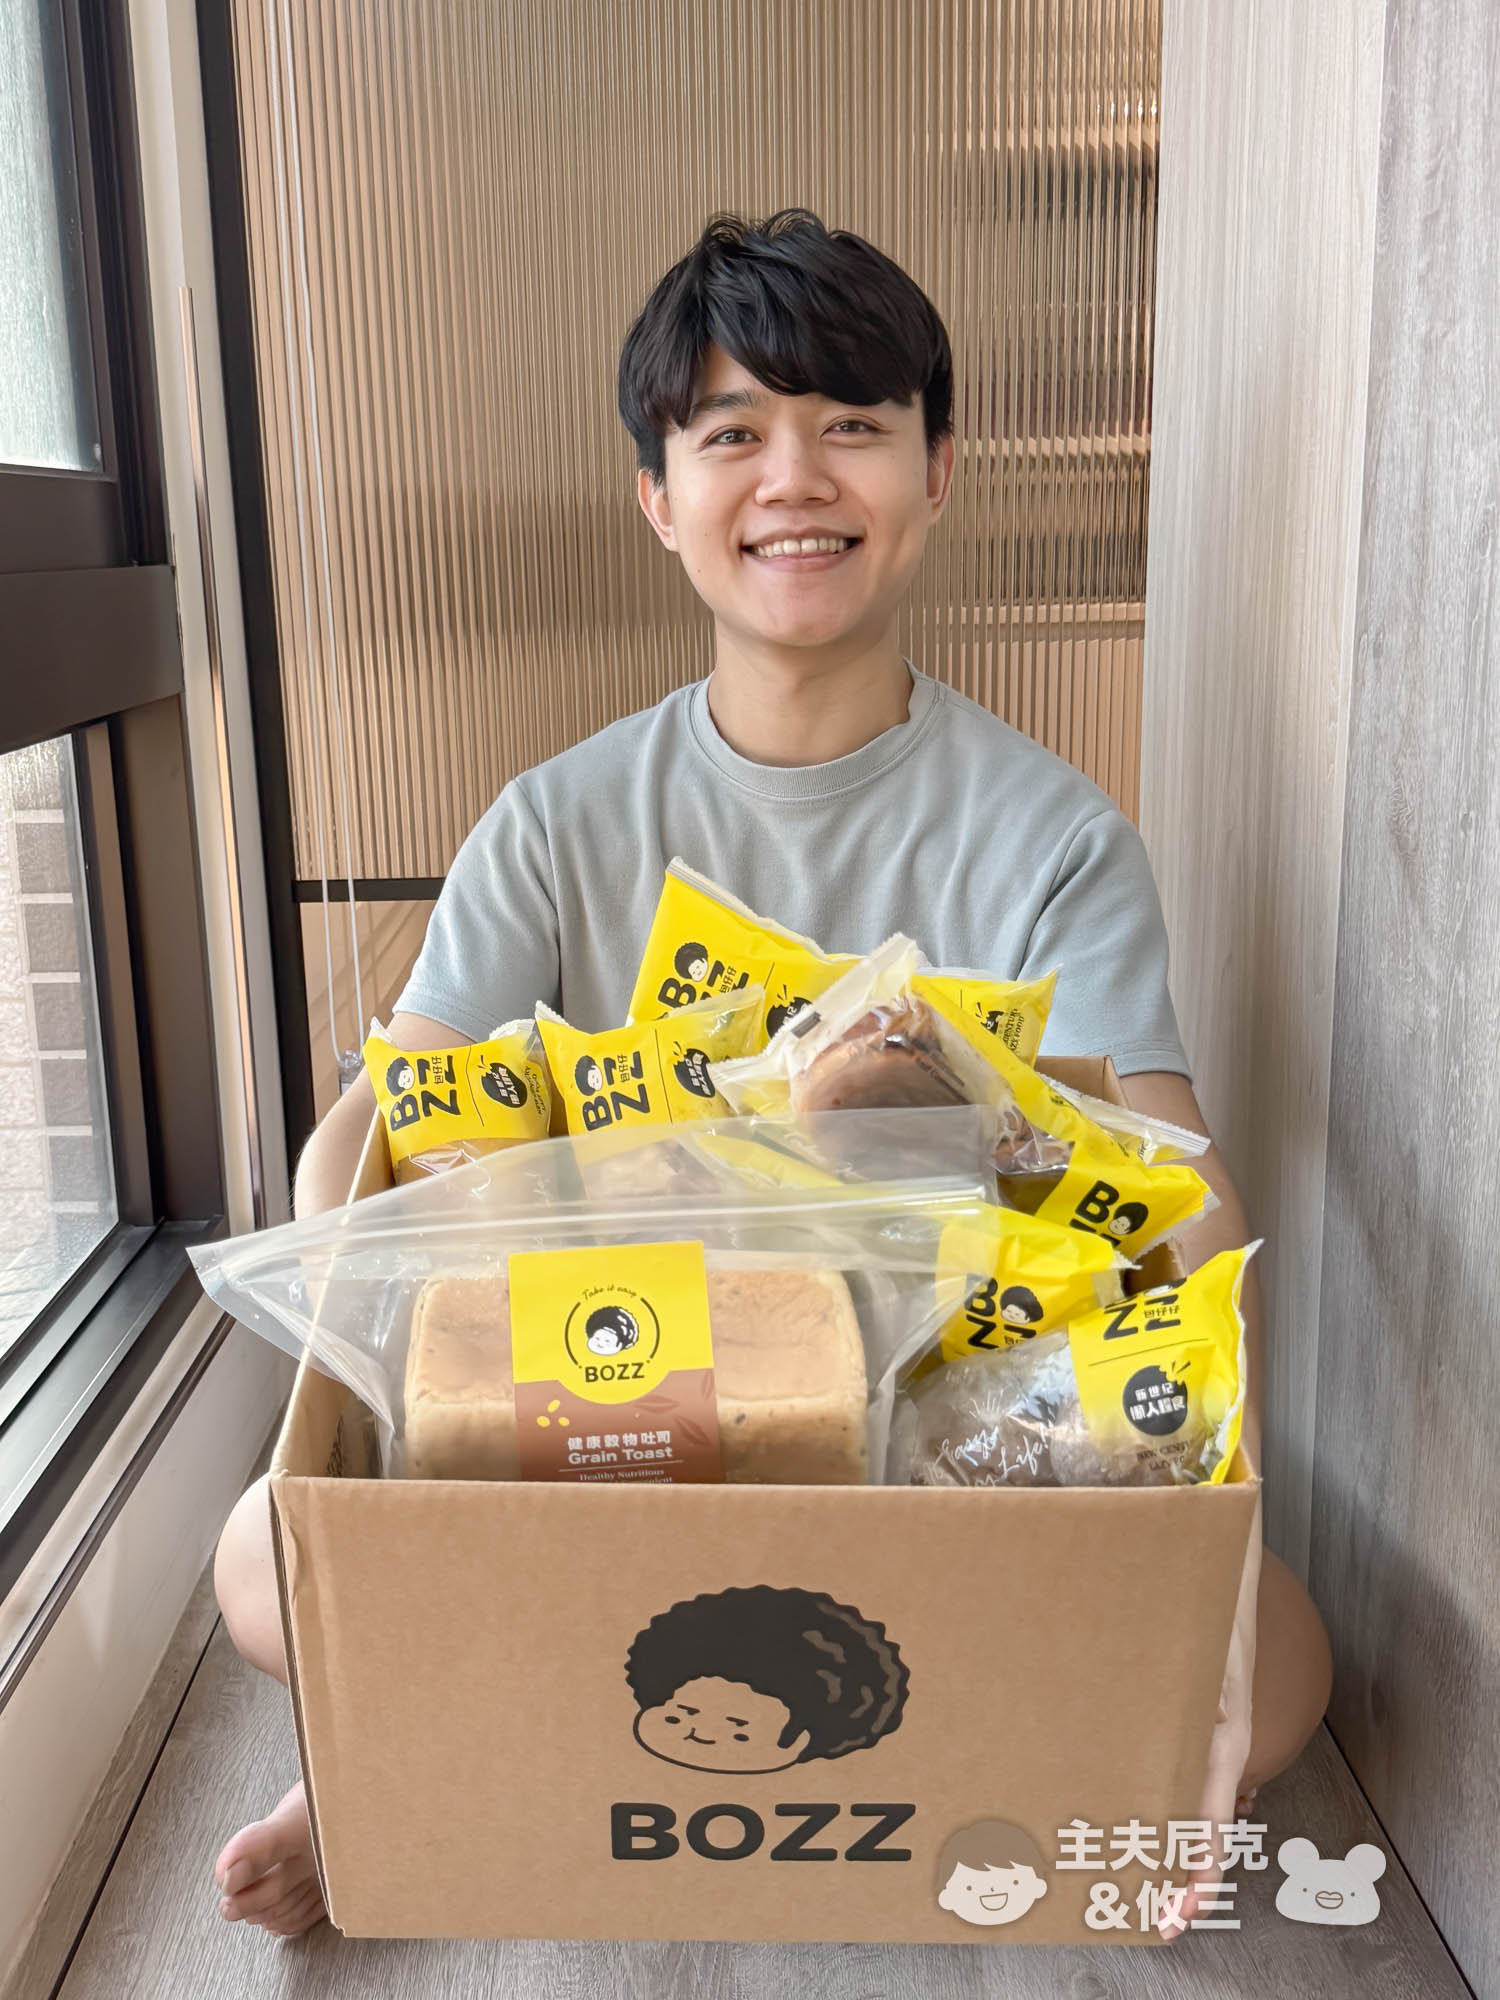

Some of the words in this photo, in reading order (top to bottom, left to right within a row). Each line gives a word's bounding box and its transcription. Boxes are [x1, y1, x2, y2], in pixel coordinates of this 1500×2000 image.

[582, 1286, 604, 1300] Take
[585, 1362, 645, 1383] BOZZ
[568, 1450, 617, 1465] Grain
[622, 1446, 673, 1460] Toast
[579, 1471, 615, 1481] Healthy
[617, 1469, 664, 1480] Nutritious
[611, 1803, 916, 1862] BOZZ
